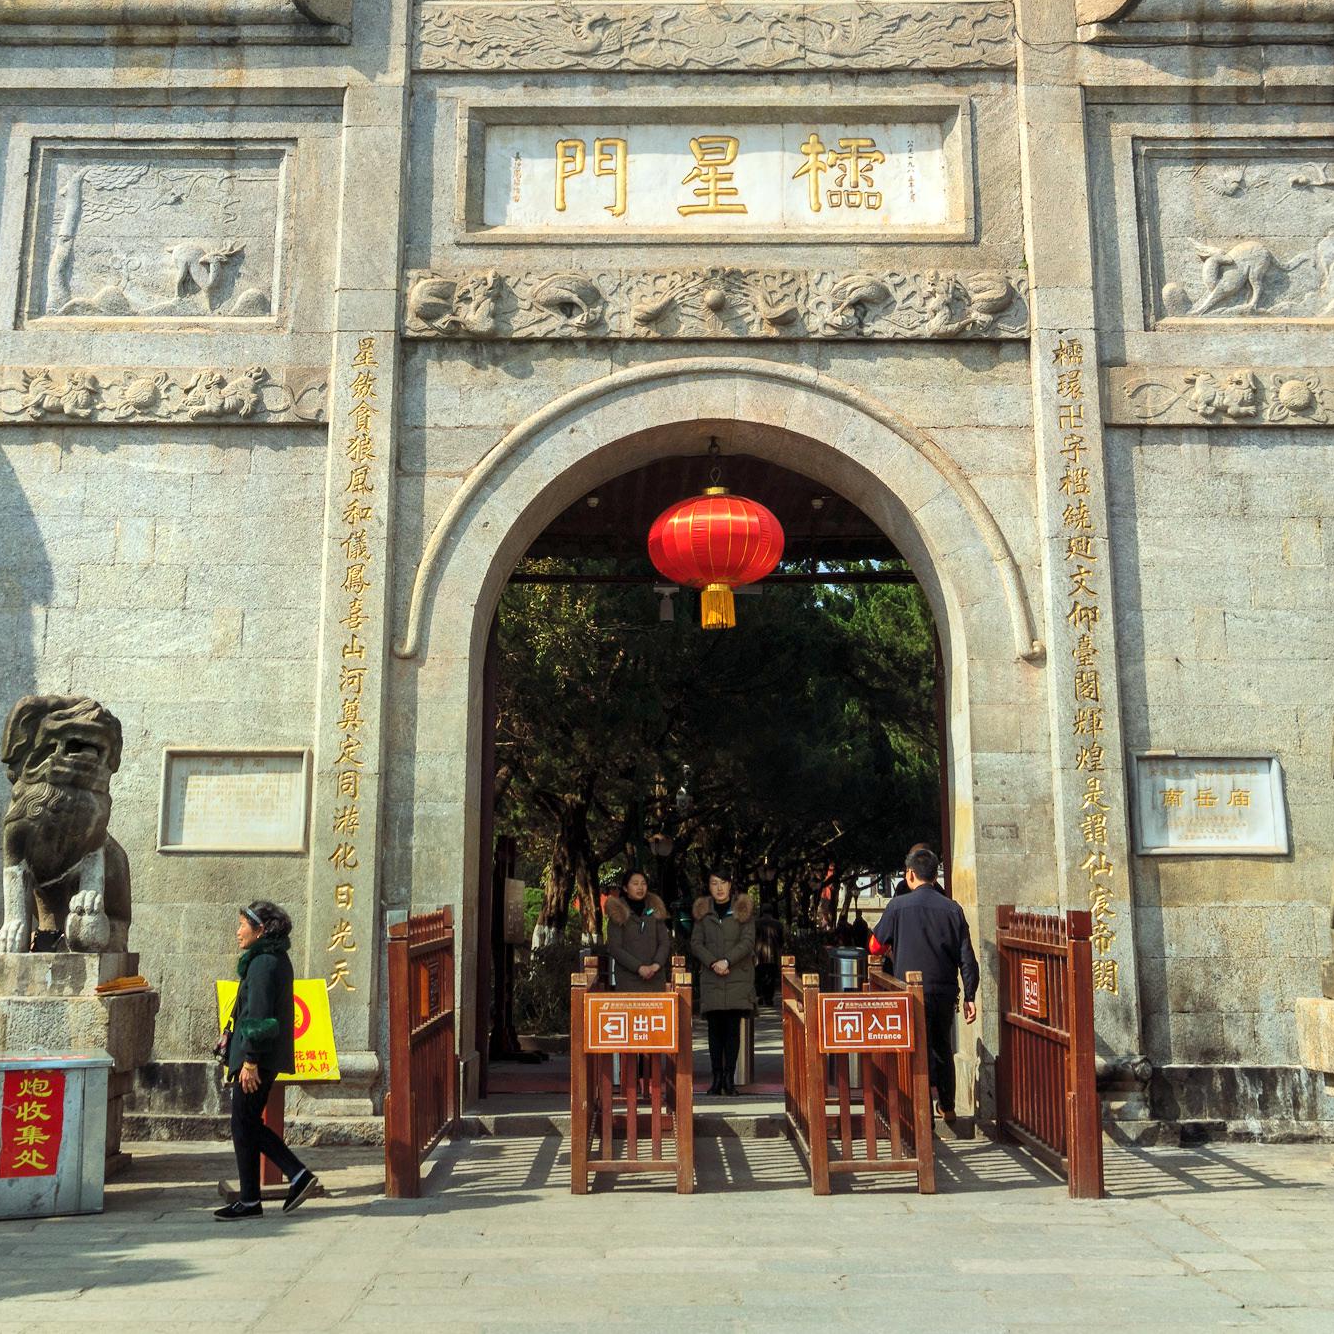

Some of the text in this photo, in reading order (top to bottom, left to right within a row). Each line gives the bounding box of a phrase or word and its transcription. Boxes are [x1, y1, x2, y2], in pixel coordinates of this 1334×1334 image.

[1159, 787, 1252, 808] 南岳庙
[633, 1014, 666, 1032] 出口
[868, 1014, 902, 1031] 入口
[633, 1033, 648, 1041] Exit
[12, 1070, 53, 1170] 炮收集处
